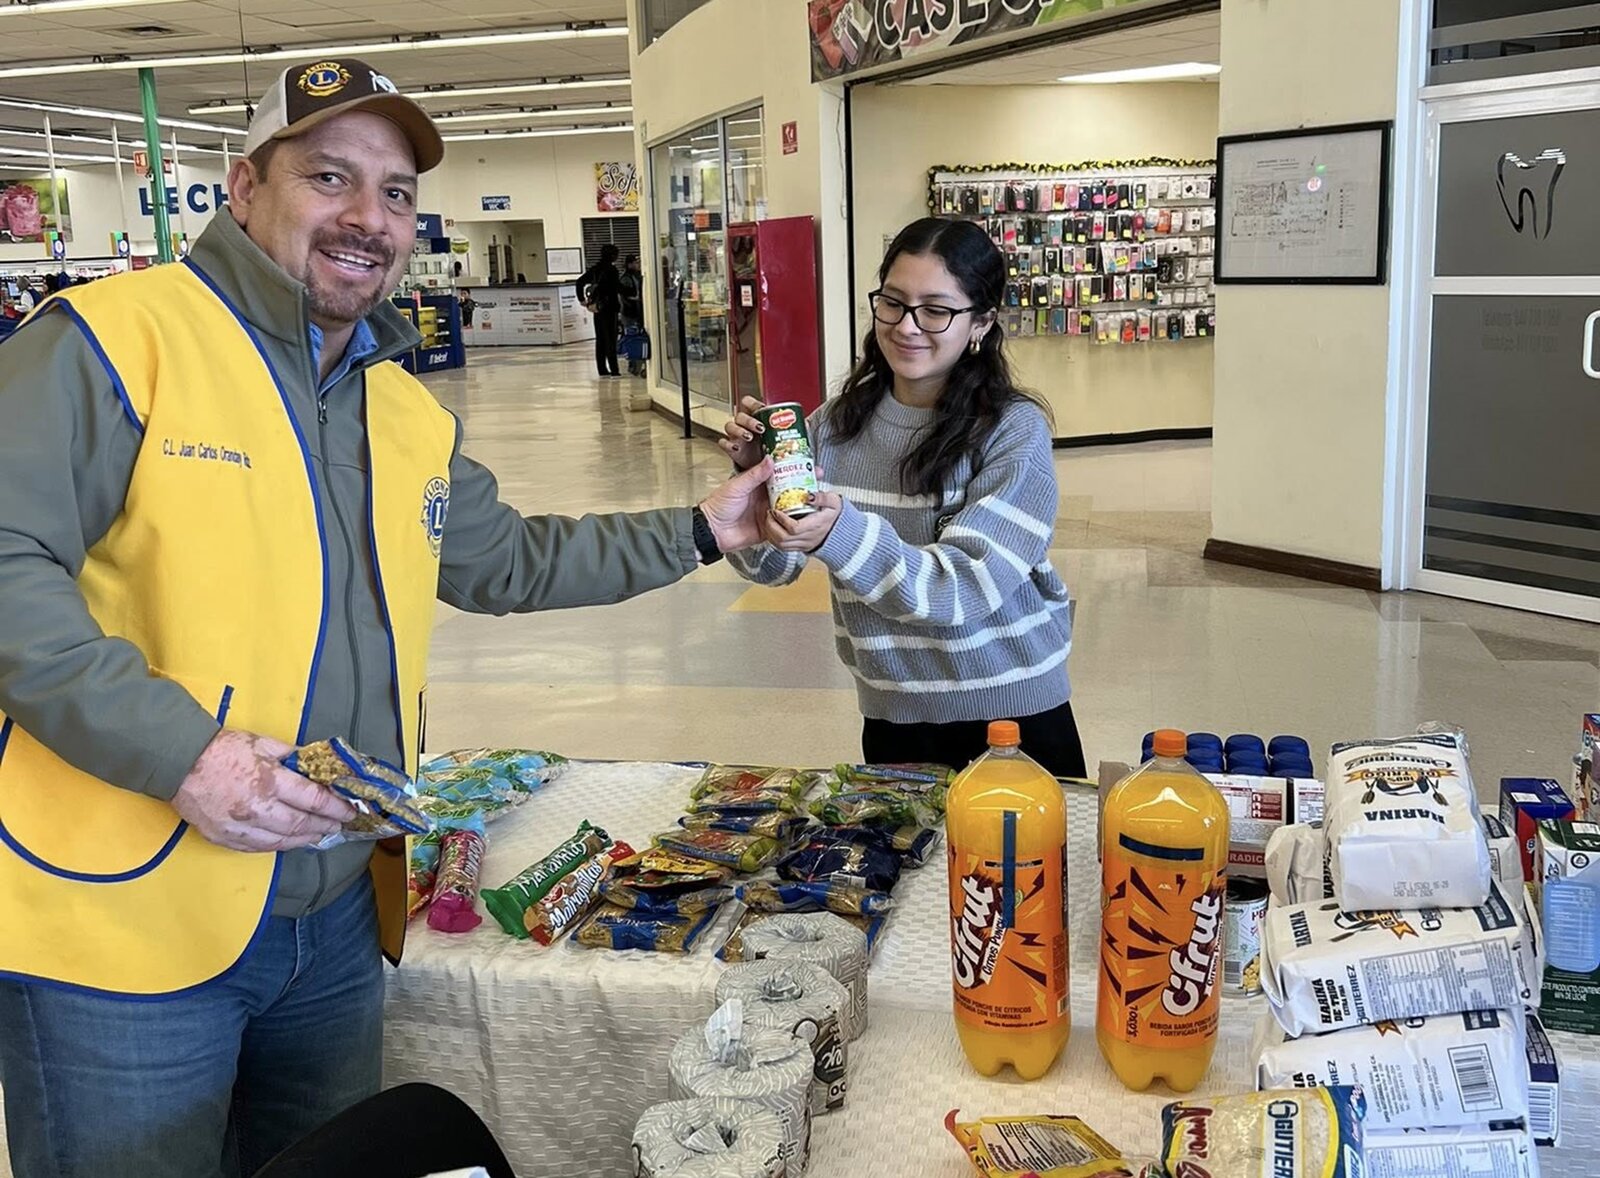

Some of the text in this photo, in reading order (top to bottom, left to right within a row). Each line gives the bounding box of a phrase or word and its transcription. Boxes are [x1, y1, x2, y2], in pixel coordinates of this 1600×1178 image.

[179, 440, 195, 457] Juan
[198, 442, 218, 460] Carlos
[427, 480, 449, 497] LIONS
[1364, 809, 1445, 824] HARINA
[1229, 853, 1264, 864] RADIC
[1289, 911, 1312, 948] HARINA
[1161, 894, 1221, 1017] Cifrut
[1311, 977, 1333, 1024] HARINA
[1325, 979, 1344, 1022] DE TRIGO
[1275, 1119, 1294, 1178] GUTIER
